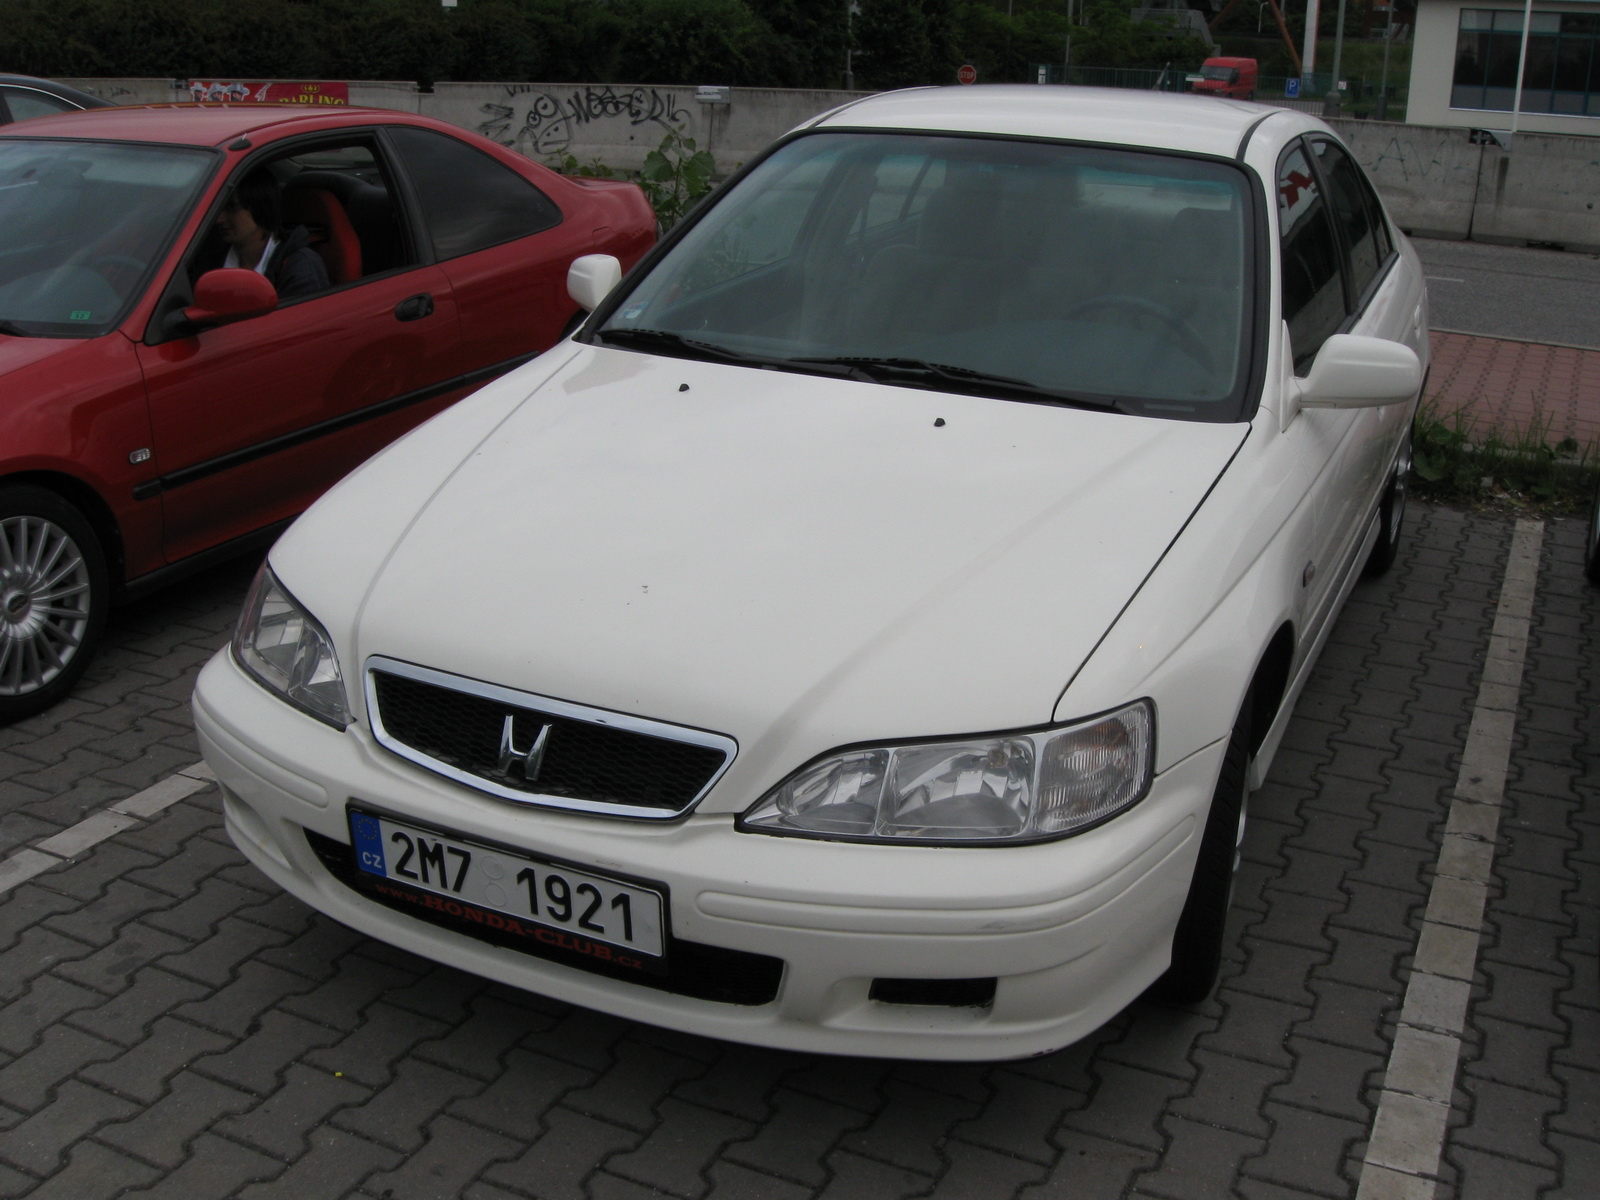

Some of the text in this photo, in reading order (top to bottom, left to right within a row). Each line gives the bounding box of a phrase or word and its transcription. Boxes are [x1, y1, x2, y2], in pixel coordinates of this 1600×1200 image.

[959, 71, 975, 79] STOP
[1289, 80, 1297, 91] P
[362, 851, 382, 869] CZ
[391, 831, 633, 942] 2M7 1921
[375, 884, 642, 969] www.HONDA-CLUB.cz
